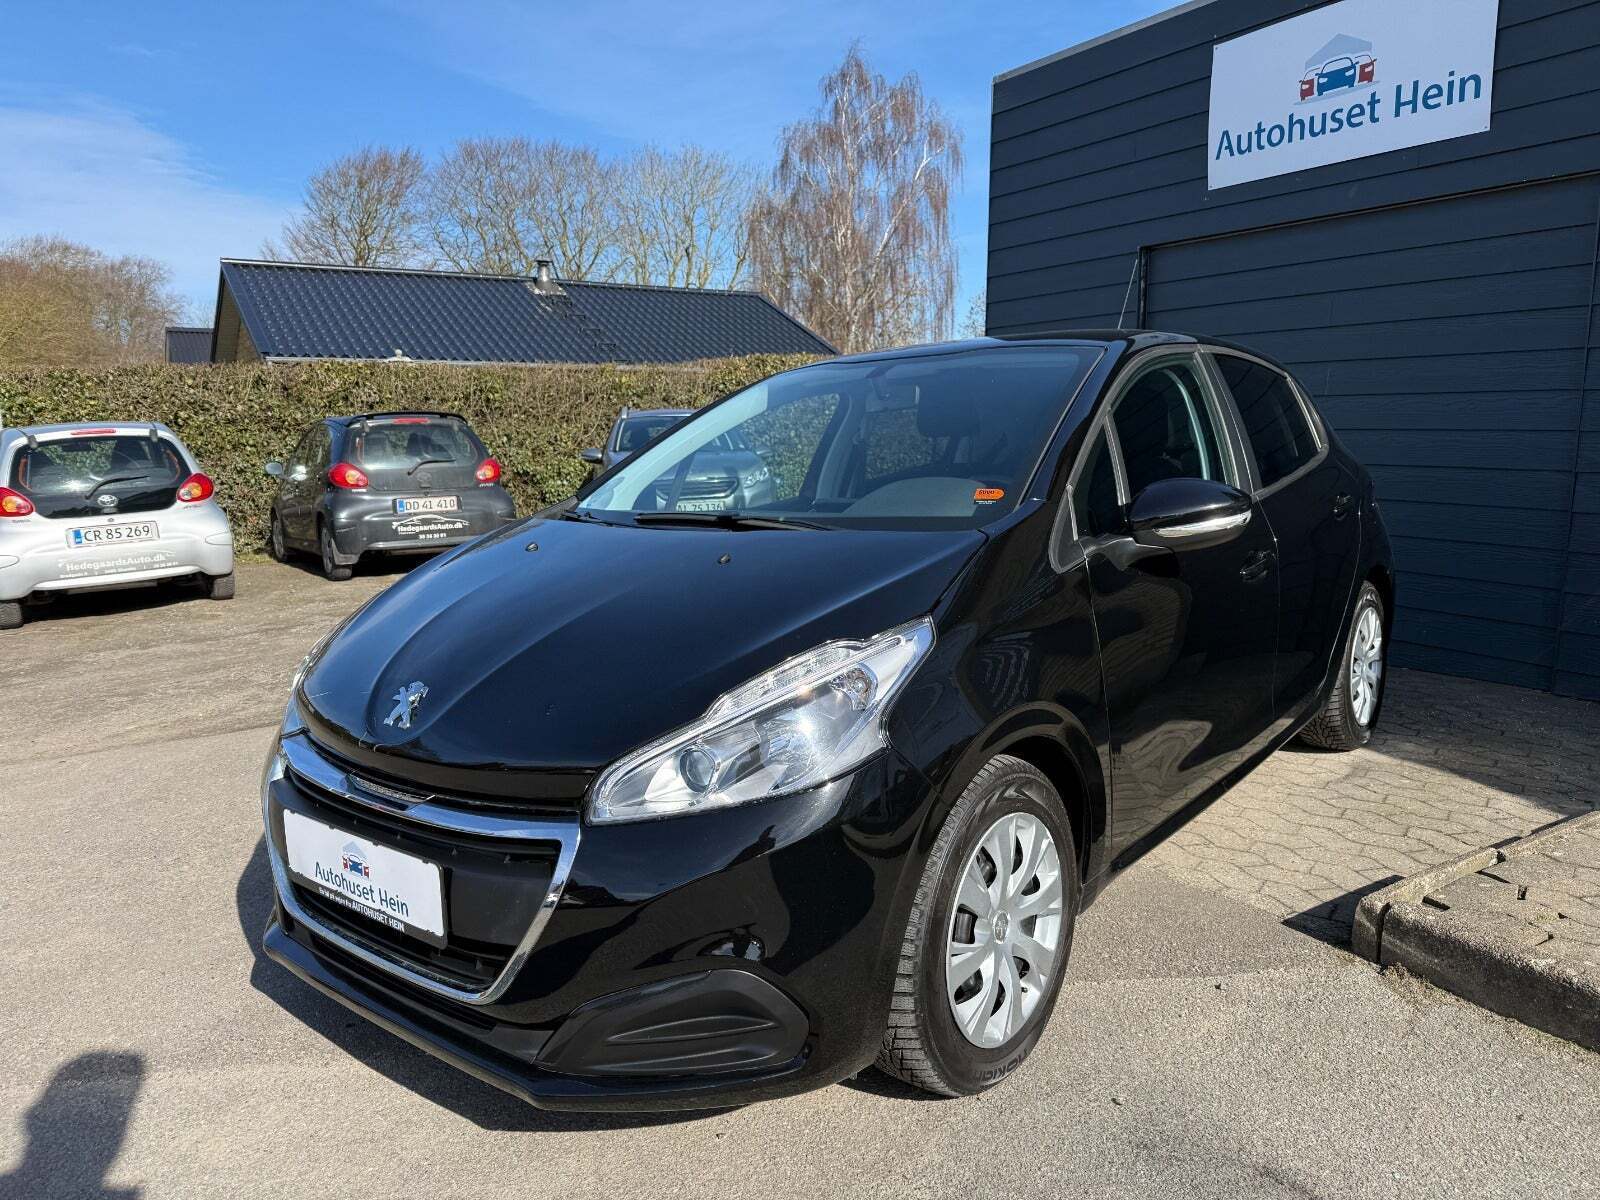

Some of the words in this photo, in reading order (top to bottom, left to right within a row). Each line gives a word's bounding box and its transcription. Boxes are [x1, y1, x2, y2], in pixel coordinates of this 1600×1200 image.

[1215, 91, 1381, 161] Autohuset
[1394, 70, 1482, 118] Hein
[405, 501, 420, 511] DD
[422, 500, 433, 510] 41
[437, 499, 455, 508] 410
[84, 530, 102, 542] CR
[106, 528, 122, 540] 85
[126, 525, 150, 538] 269
[315, 861, 376, 904] Autohuset
[378, 887, 410, 918] Hein
[352, 900, 389, 925] AUTOHUSET
[389, 917, 405, 933] HEIN
